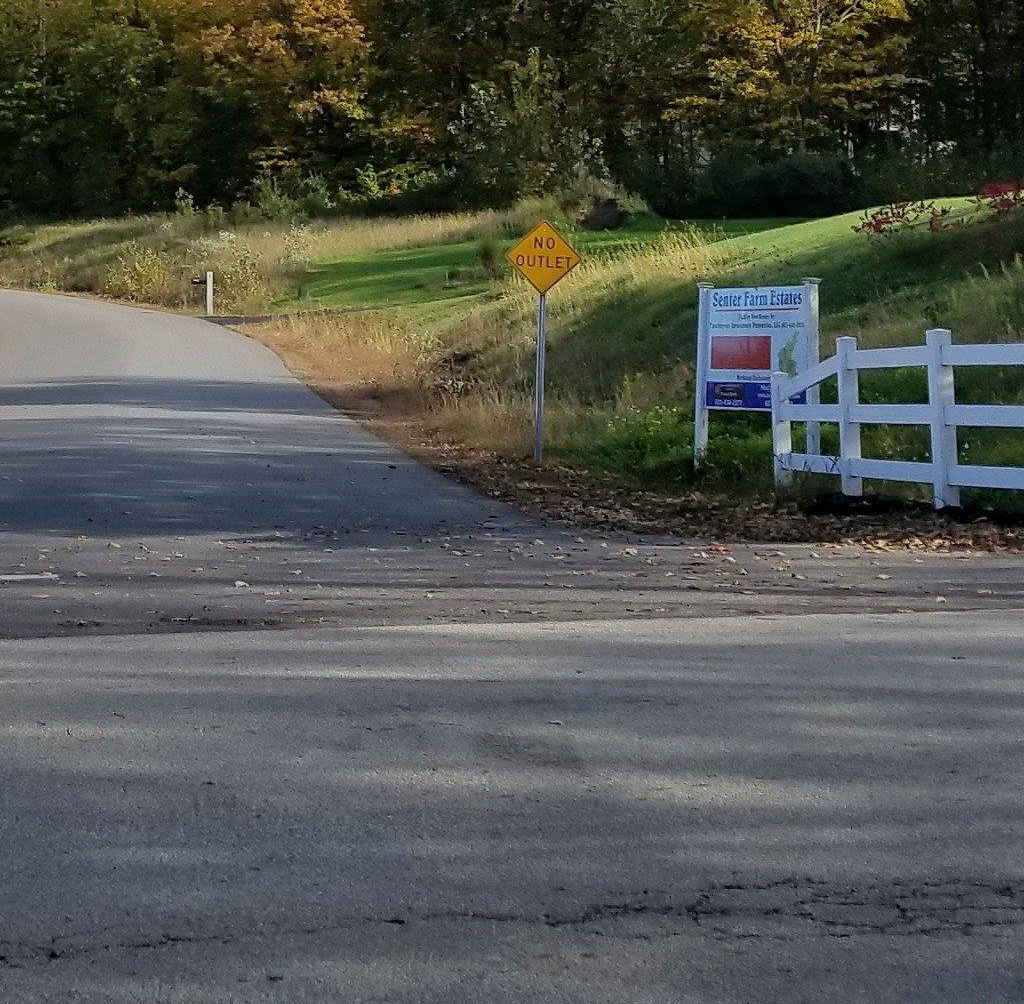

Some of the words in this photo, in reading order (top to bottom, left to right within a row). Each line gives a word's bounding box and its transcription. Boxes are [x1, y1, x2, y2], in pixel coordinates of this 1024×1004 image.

[533, 237, 556, 249] NO
[516, 254, 573, 269] OUTLET
[712, 292, 741, 307] Senter
[744, 291, 768, 307] Farm
[770, 290, 803, 306] Estates
